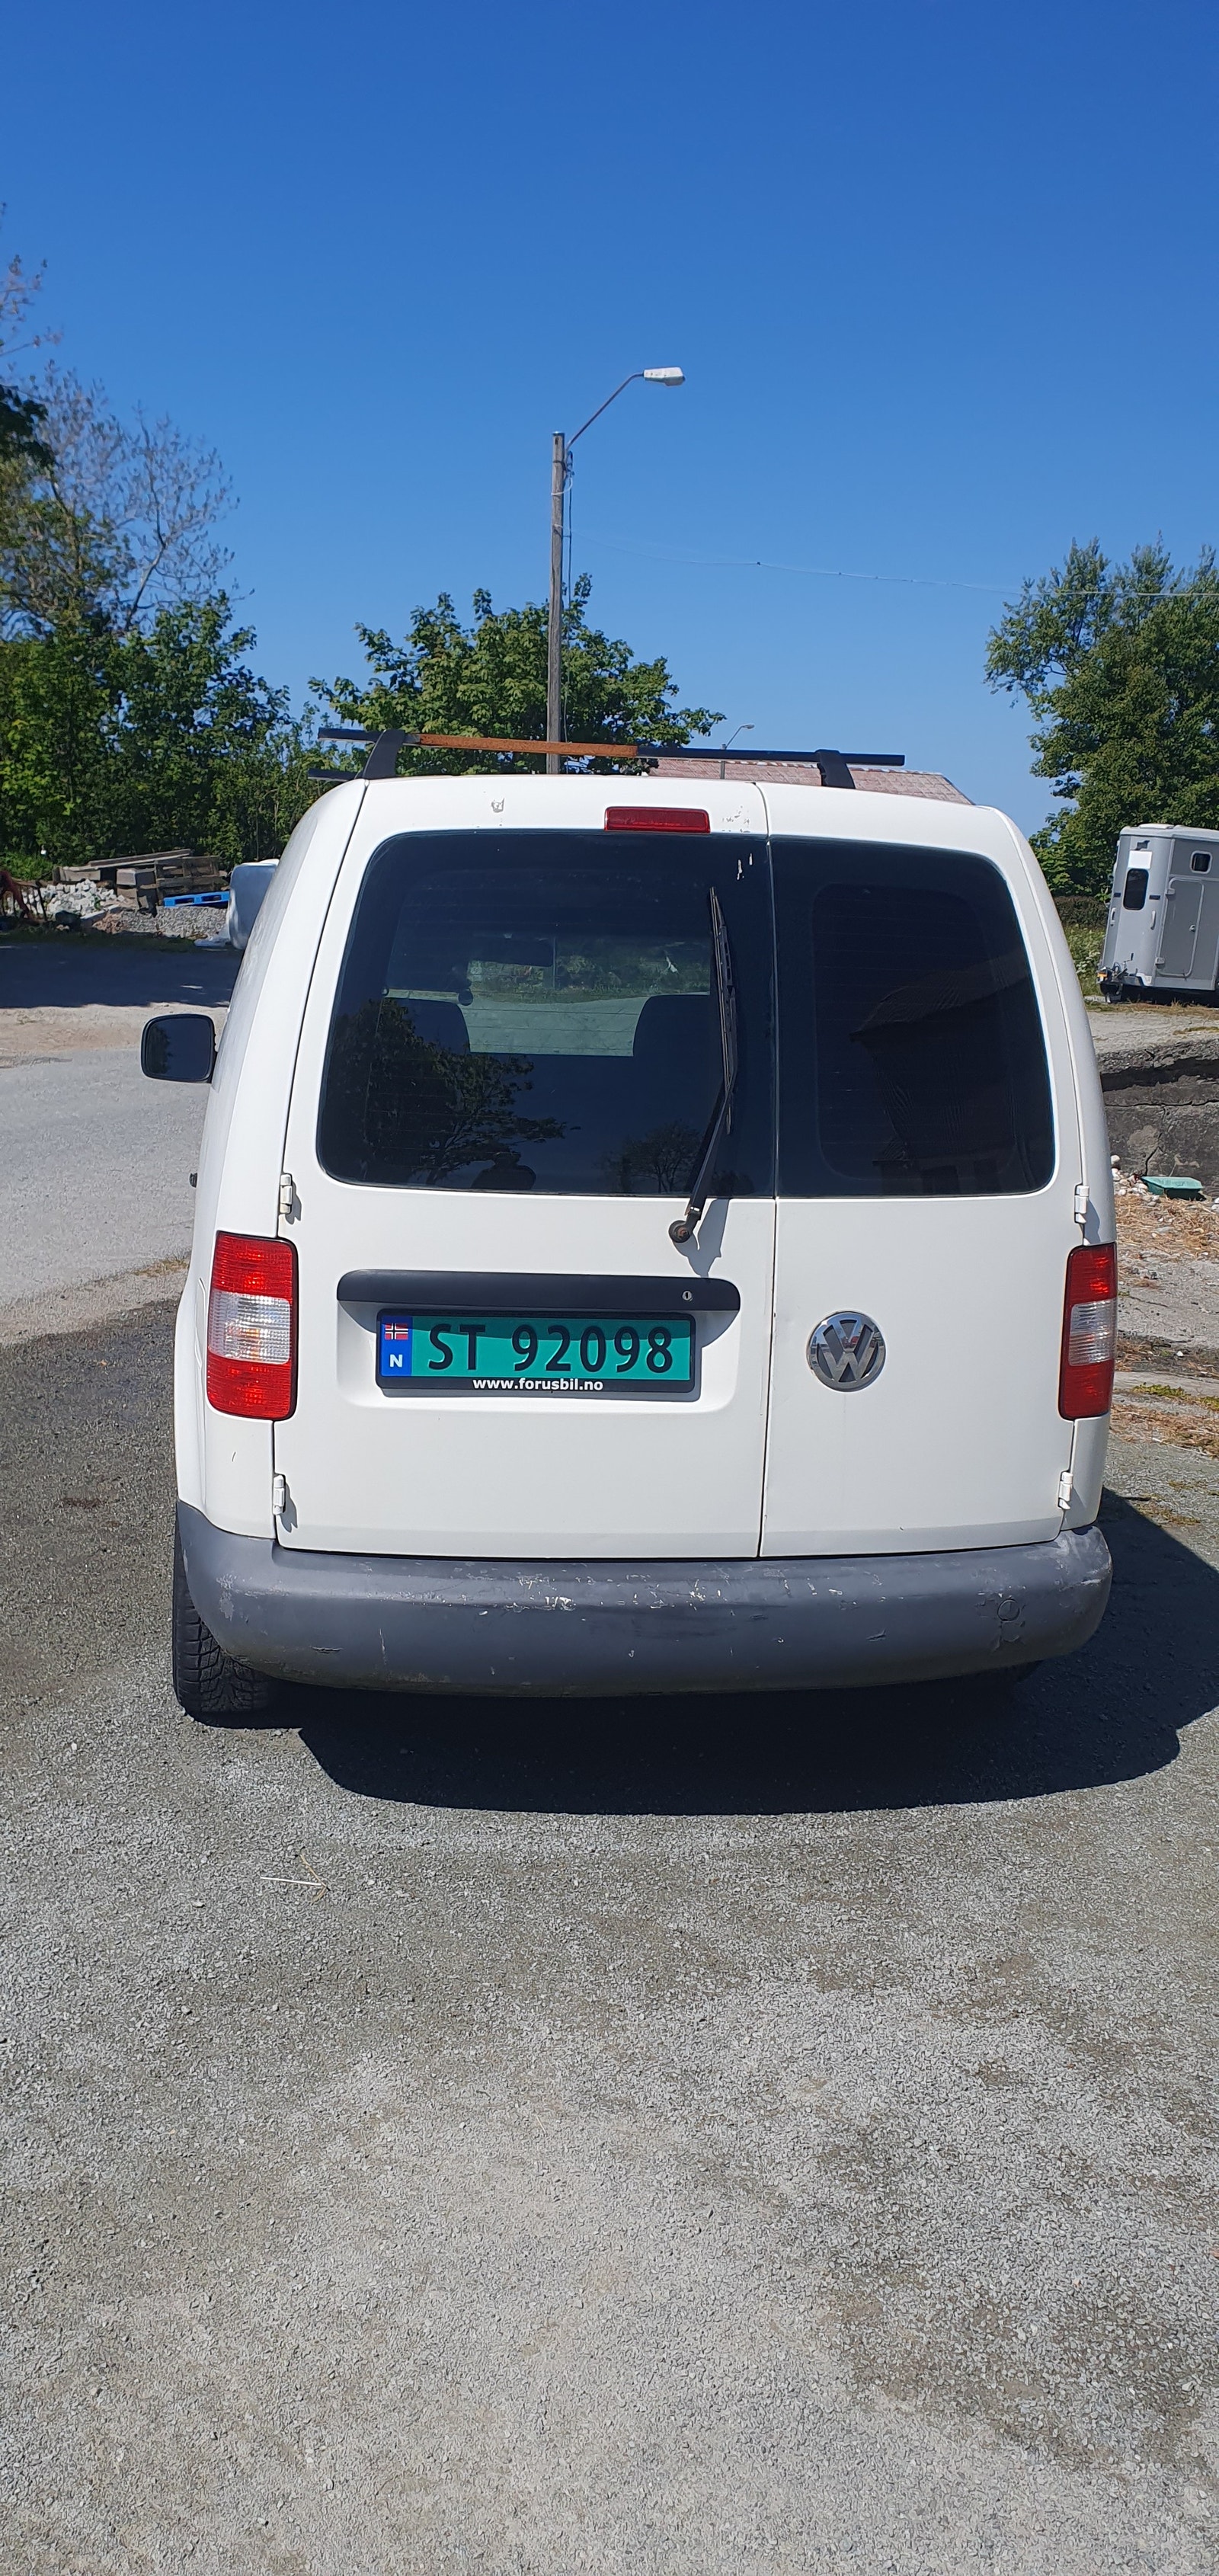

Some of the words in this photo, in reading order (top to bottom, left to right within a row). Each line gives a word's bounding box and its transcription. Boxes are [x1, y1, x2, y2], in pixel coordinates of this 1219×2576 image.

[389, 1354, 403, 1368] N
[428, 1323, 485, 1371] ST
[511, 1324, 673, 1373] 92098
[810, 1312, 884, 1390] VW
[472, 1378, 603, 1391] www.forusbil.no
